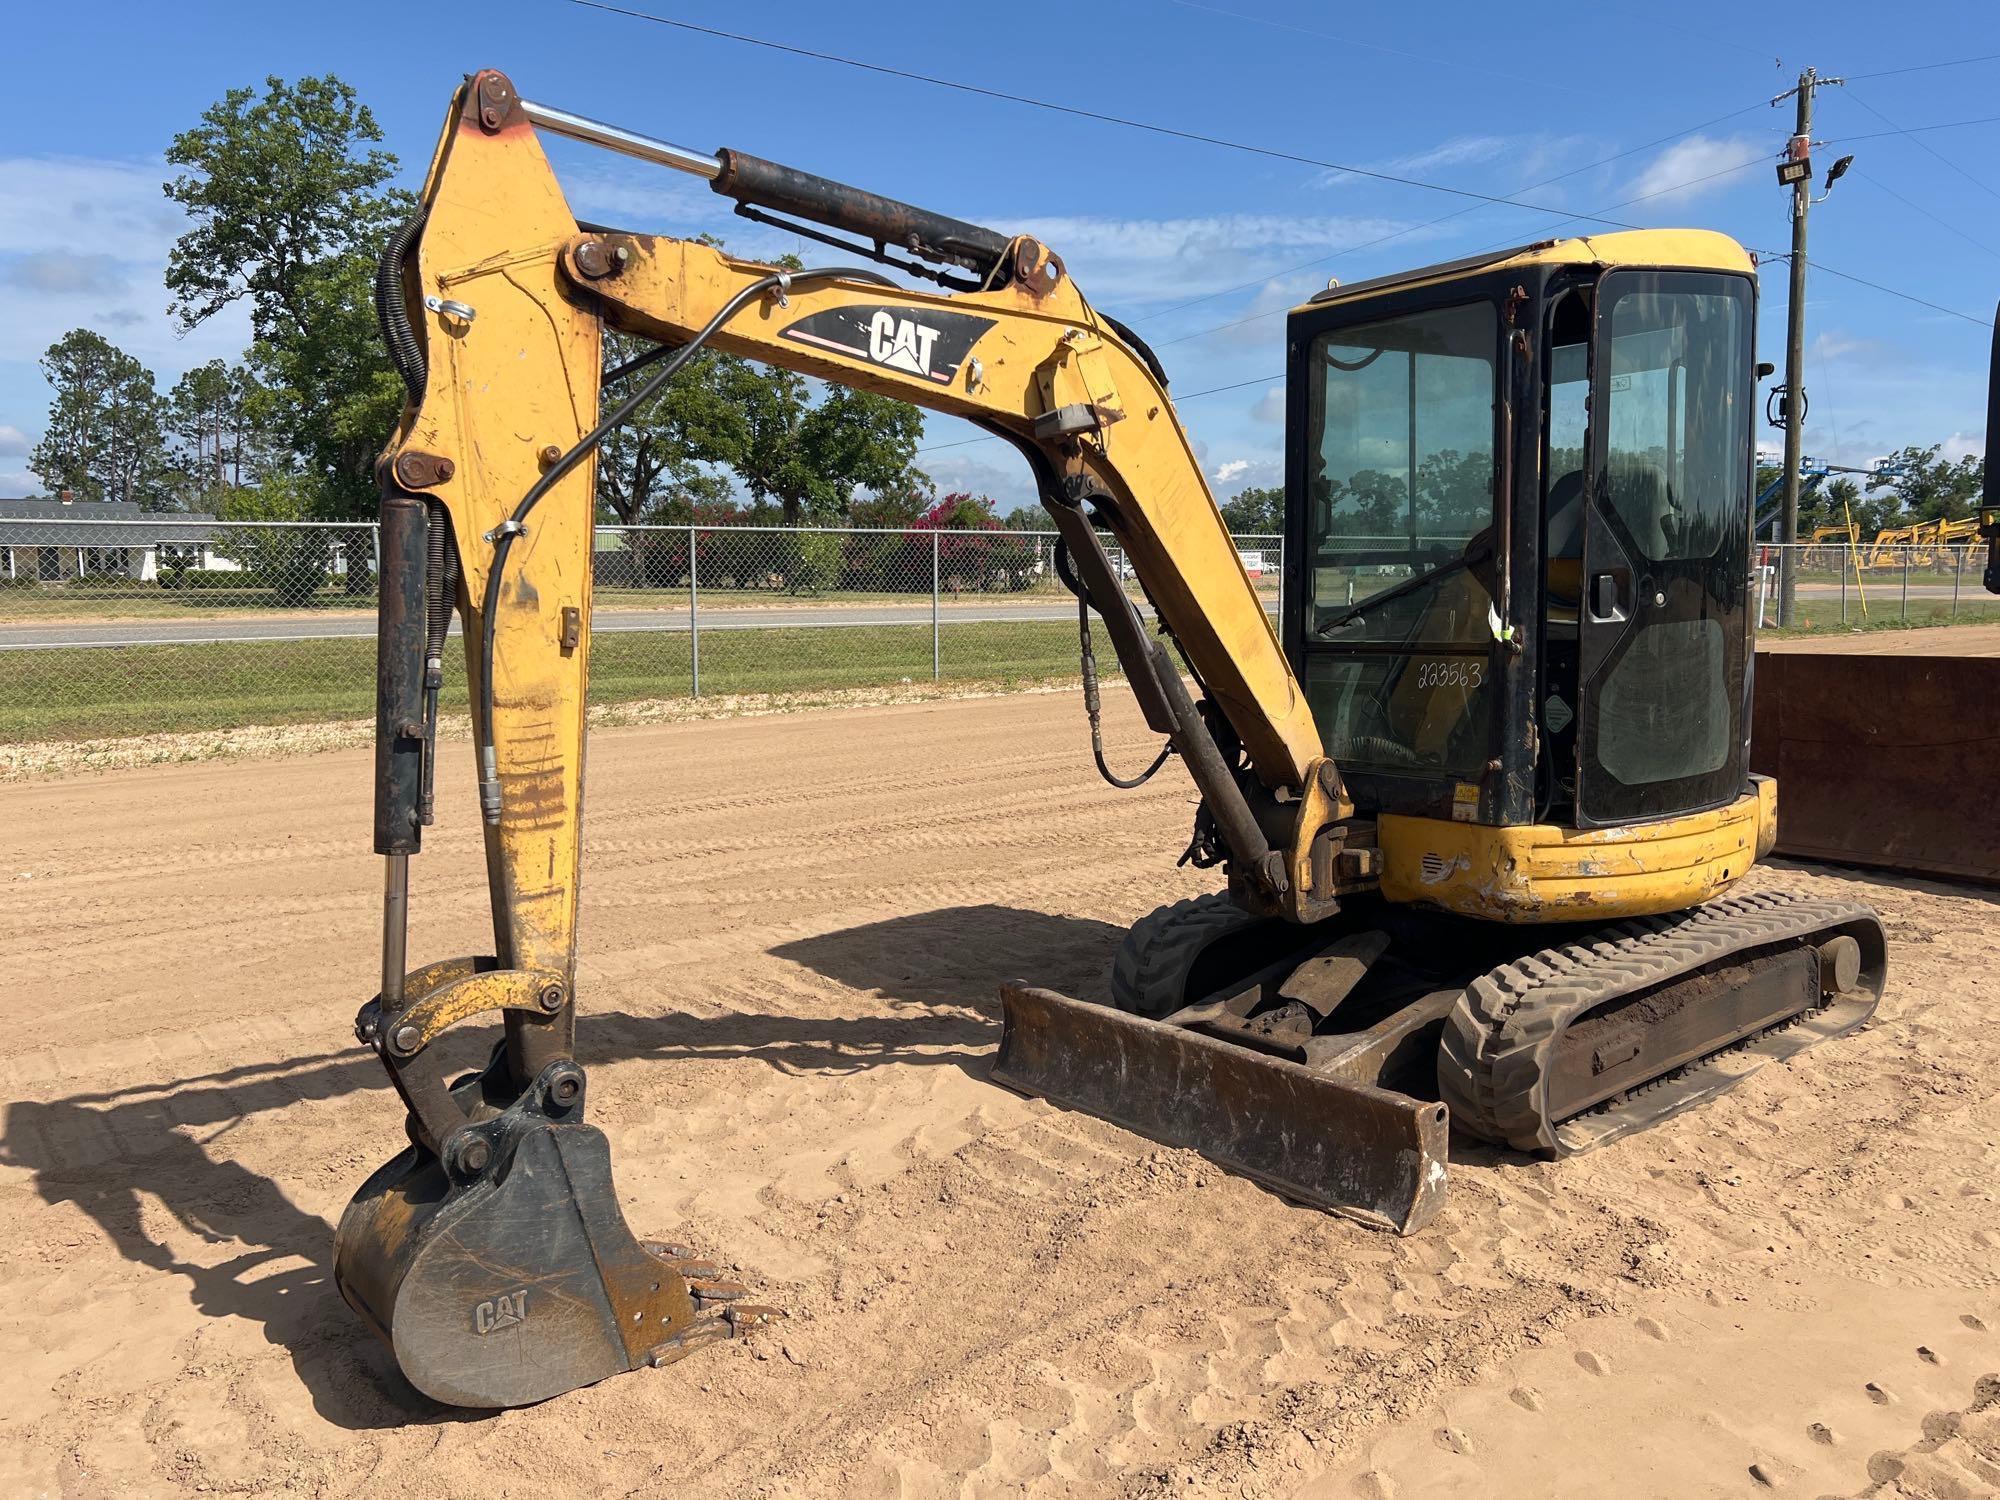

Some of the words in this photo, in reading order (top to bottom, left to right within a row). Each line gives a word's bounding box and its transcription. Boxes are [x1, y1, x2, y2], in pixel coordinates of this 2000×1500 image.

[869, 311, 940, 375] CAT
[1418, 662, 1482, 689] 223563
[476, 1289, 528, 1334] CAT
